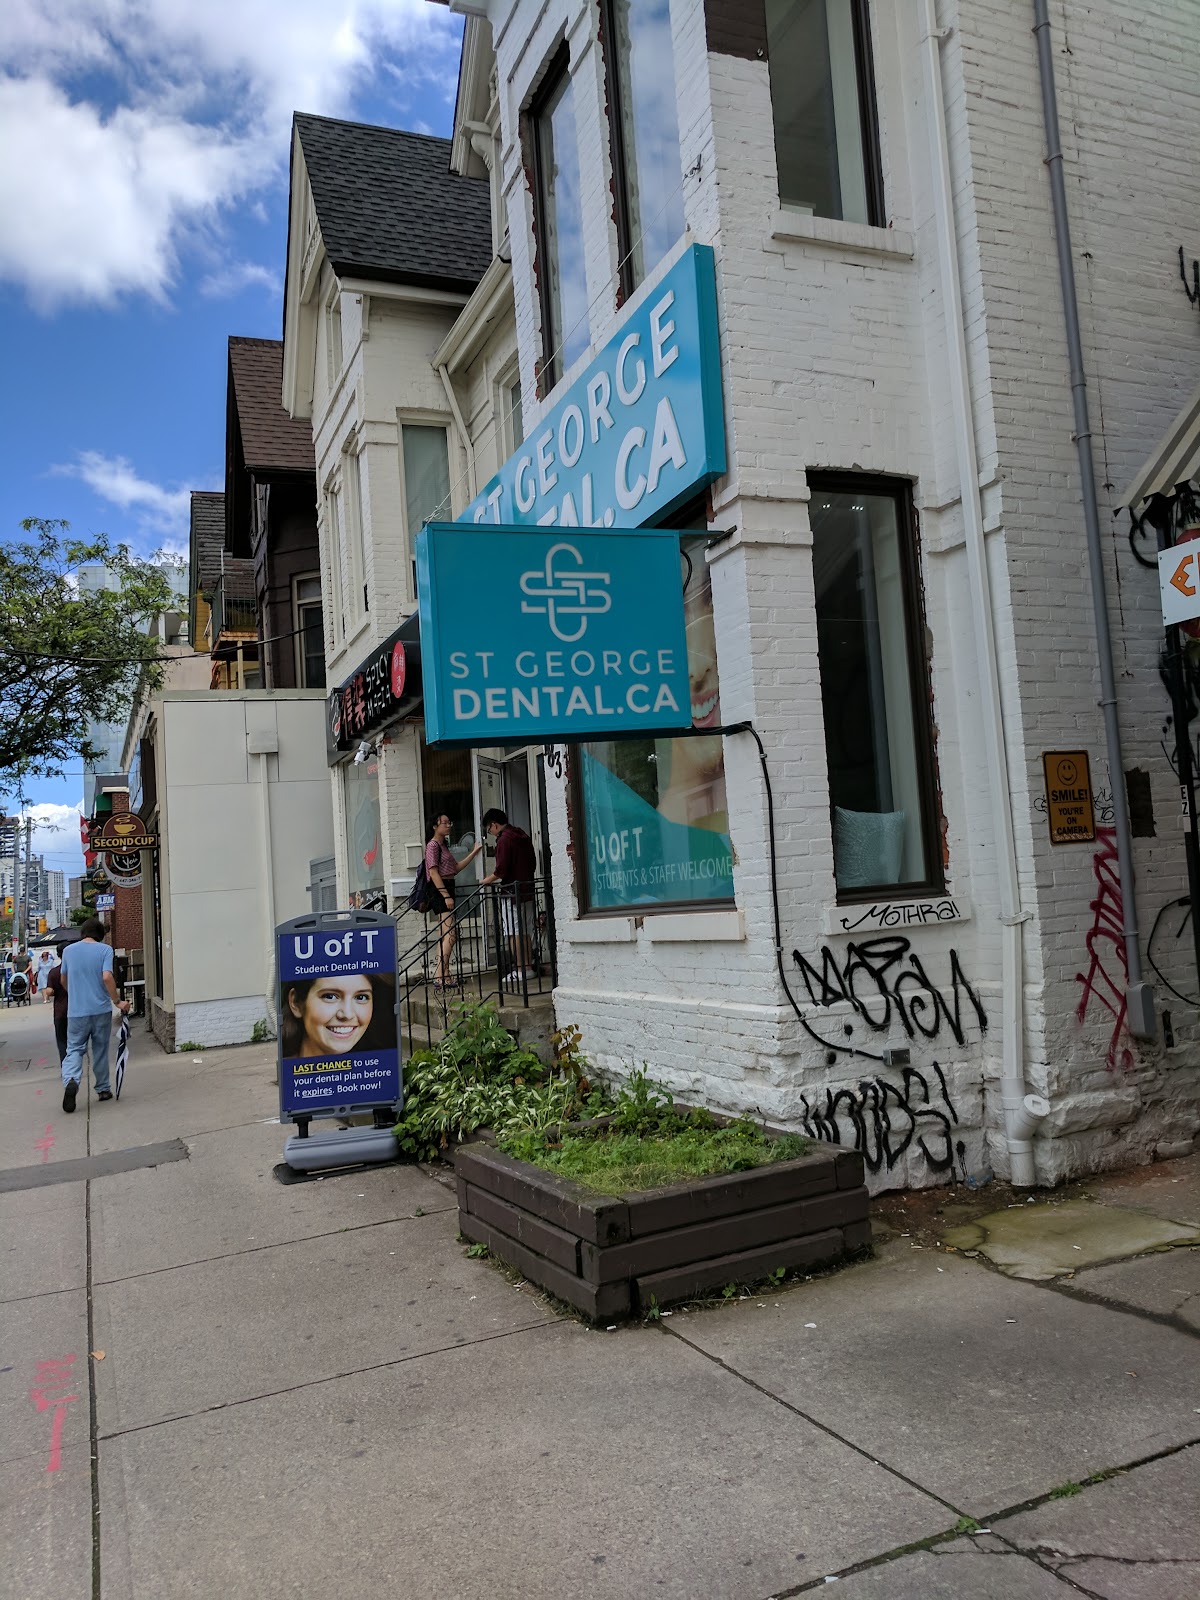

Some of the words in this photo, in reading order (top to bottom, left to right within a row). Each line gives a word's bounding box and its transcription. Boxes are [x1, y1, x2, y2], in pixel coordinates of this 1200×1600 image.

[514, 290, 679, 513] GEORGE
[450, 651, 494, 678] ST
[515, 649, 676, 678] GEORGE
[453, 683, 680, 720] DENTAL.CA
[1051, 788, 1088, 802] SMILE!
[1058, 806, 1084, 816] YOU'RE
[1066, 816, 1077, 825] ON
[1056, 826, 1089, 835] CAMERA
[94, 837, 134, 848] SECOND
[134, 836, 154, 845] CUP
[597, 868, 638, 891] STUDENTS
[648, 863, 676, 884] STAFF
[678, 855, 733, 880] WELCOME
[294, 935, 314, 960] U
[324, 932, 354, 957] of
[360, 930, 379, 954] T
[295, 964, 329, 975] Student
[331, 961, 359, 972] Dental
[361, 960, 379, 969] Plan
[293, 1063, 314, 1074] LAST
[316, 1060, 352, 1071] CHANCE
[353, 1060, 363, 1068] to
[365, 1058, 379, 1066] use
[294, 1077, 313, 1087] your
[315, 1073, 342, 1083] dental
[344, 1071, 362, 1082] plan
[364, 1069, 392, 1078] before
[293, 1089, 300, 1098] it
[302, 1087, 335, 1098] expires.
[337, 1083, 358, 1093] Book
[360, 1081, 381, 1091] now!
